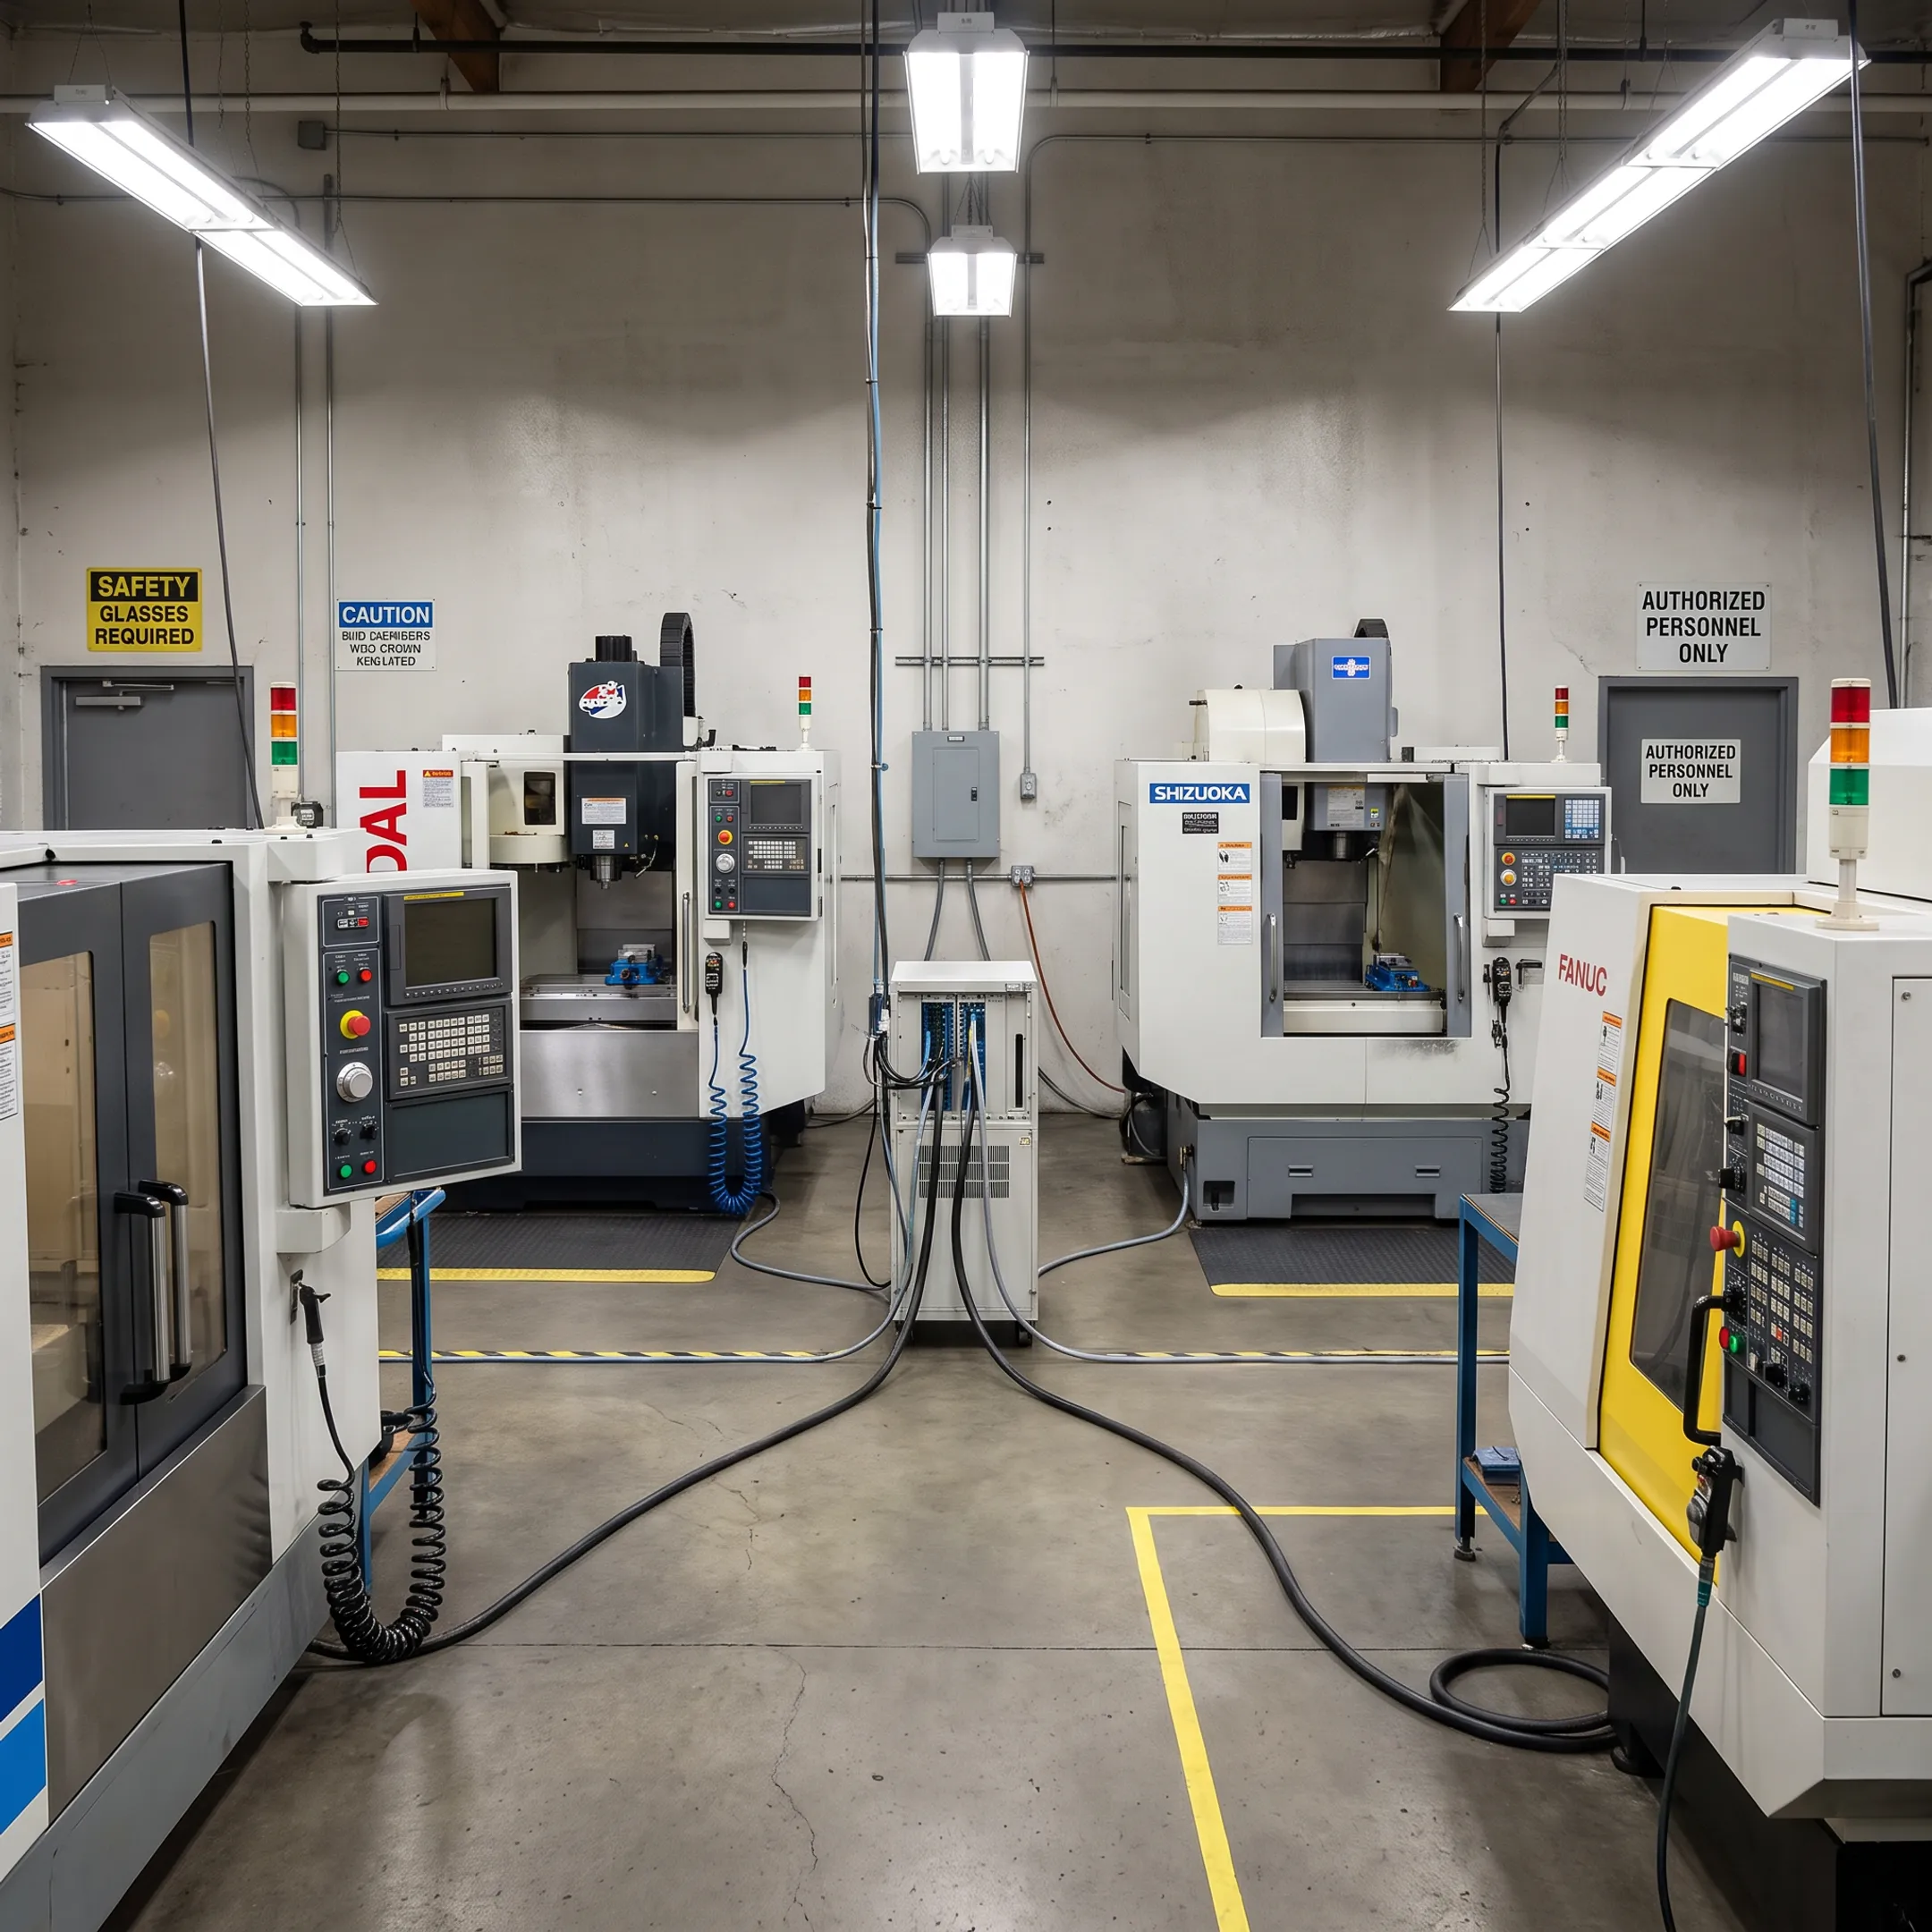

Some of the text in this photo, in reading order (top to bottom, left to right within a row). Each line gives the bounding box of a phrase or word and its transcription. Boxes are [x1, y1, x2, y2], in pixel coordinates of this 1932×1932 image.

[97, 575, 191, 597] SAFETY
[1642, 590, 1765, 611] AUTHORIZED
[99, 605, 189, 623] GLASSES
[342, 606, 429, 623] CAUTION
[95, 627, 194, 645] REQUIRED
[1646, 617, 1761, 637] PERSONNEL
[1679, 643, 1728, 663] ONLY
[1646, 744, 1736, 759] AUTHORIZED
[1648, 764, 1733, 779] PERSONNEL
[1155, 785, 1247, 801] SHIZUOKA
[1672, 783, 1709, 798] ONLY
[1558, 953, 1608, 997] FANUC
